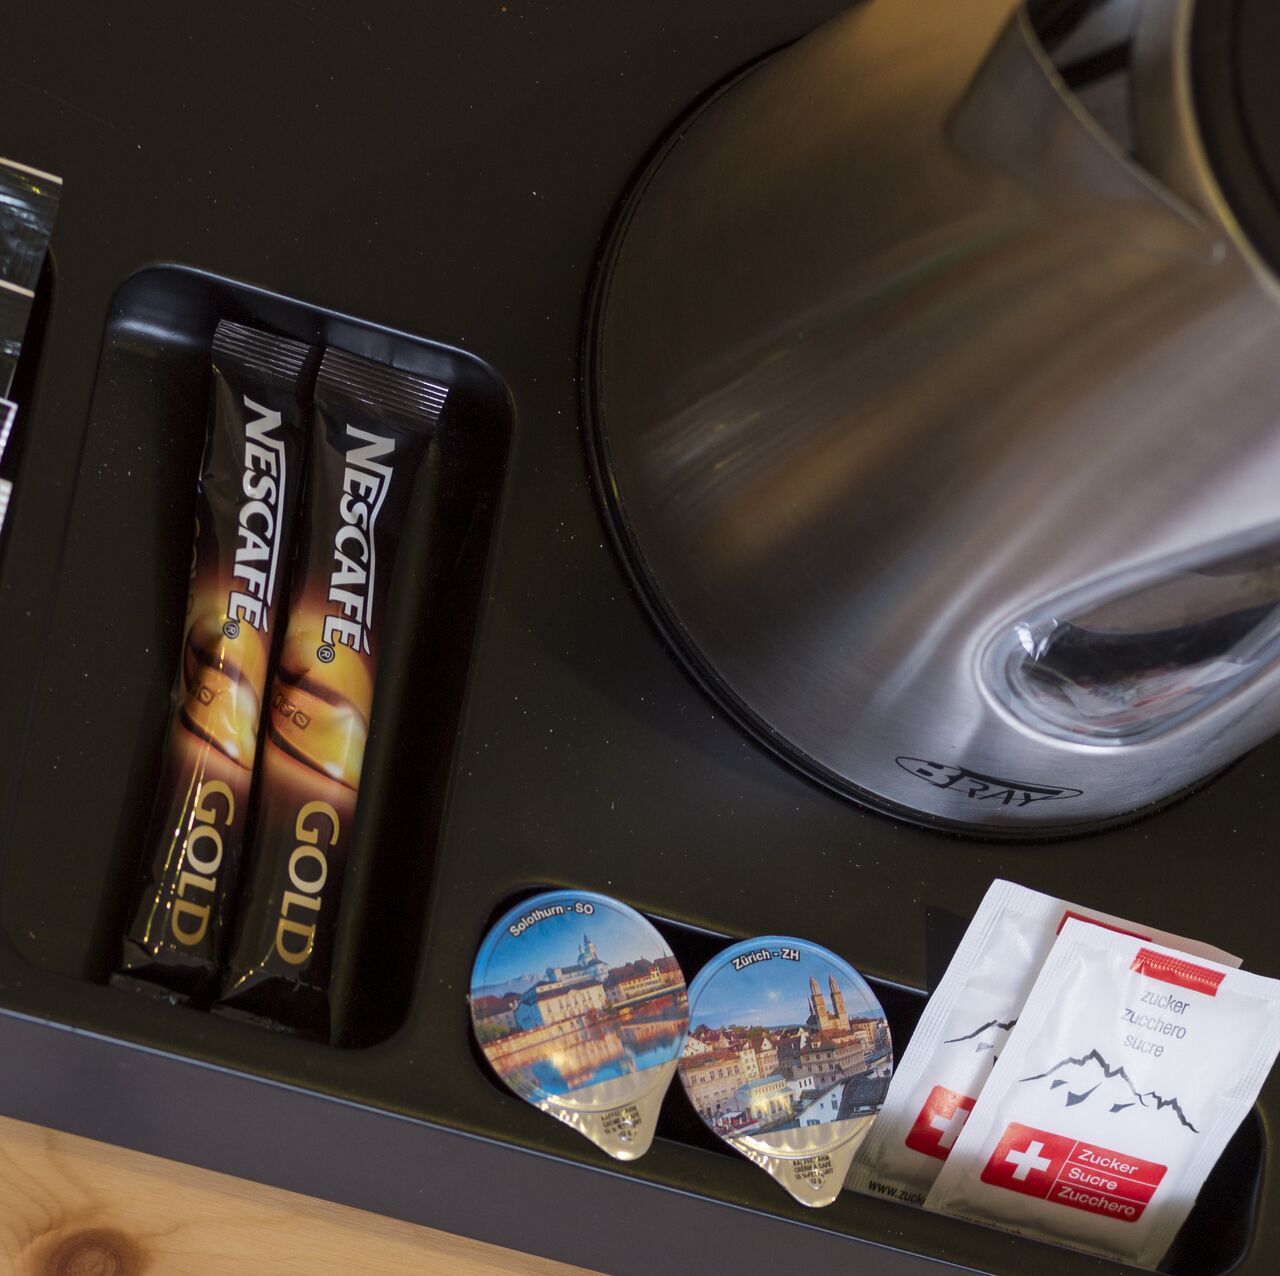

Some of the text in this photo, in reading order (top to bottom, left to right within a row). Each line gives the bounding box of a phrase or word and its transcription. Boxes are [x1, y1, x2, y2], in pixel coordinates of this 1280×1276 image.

[227, 394, 286, 633] NESCAFÉ
[323, 423, 396, 655] NESCAFÉ
[171, 780, 235, 946] GOLD
[276, 800, 340, 965] GOLD
[509, 905, 564, 937] Solothurn
[575, 902, 594, 915] SO
[732, 949, 771, 970] Zürich
[782, 948, 799, 961] ZH
[1141, 990, 1191, 1015] zucker
[1121, 1008, 1187, 1040] zucchero
[1123, 1035, 1165, 1058] sucre
[1078, 1149, 1139, 1175] Zucker
[1068, 1167, 1118, 1190] Sucre
[1057, 1186, 1136, 1216] Zucchero
